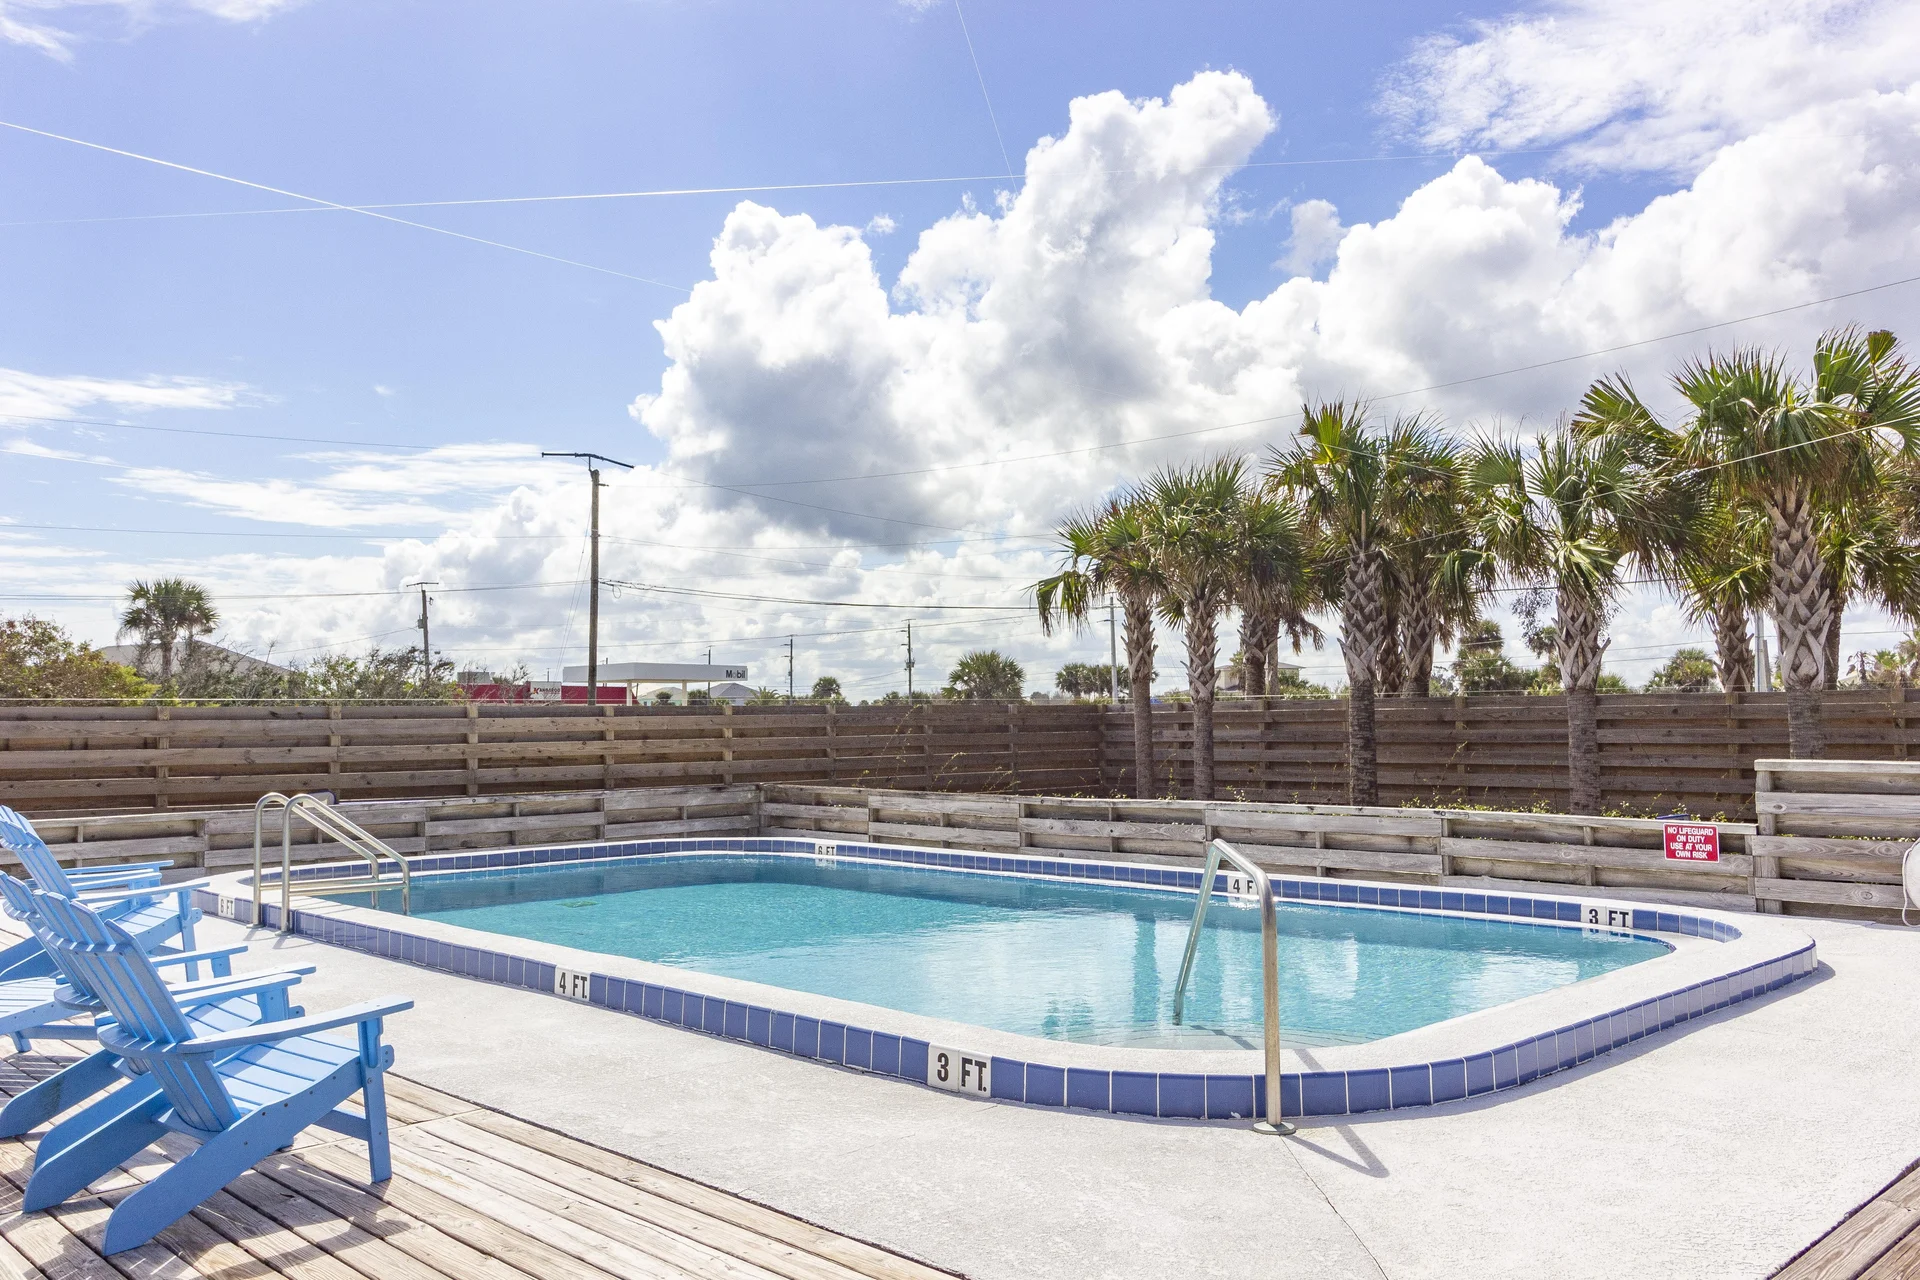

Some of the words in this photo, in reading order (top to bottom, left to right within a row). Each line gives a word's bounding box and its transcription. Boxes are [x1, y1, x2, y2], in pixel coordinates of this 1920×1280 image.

[725, 669, 745, 679] Mobil
[1667, 826, 1678, 834] NO
[1679, 827, 1714, 836] LIFEGUARD
[1670, 842, 1683, 850] USE
[1694, 844, 1713, 852] YOUR
[1675, 850, 1690, 858] OWN
[1232, 879, 1240, 893] 4
[1246, 880, 1254, 893] F
[1588, 908, 1599, 925] 3
[559, 971, 567, 994] 4
[572, 974, 588, 999] FT.
[937, 1052, 949, 1082] 3
[961, 1056, 987, 1092] FT.
